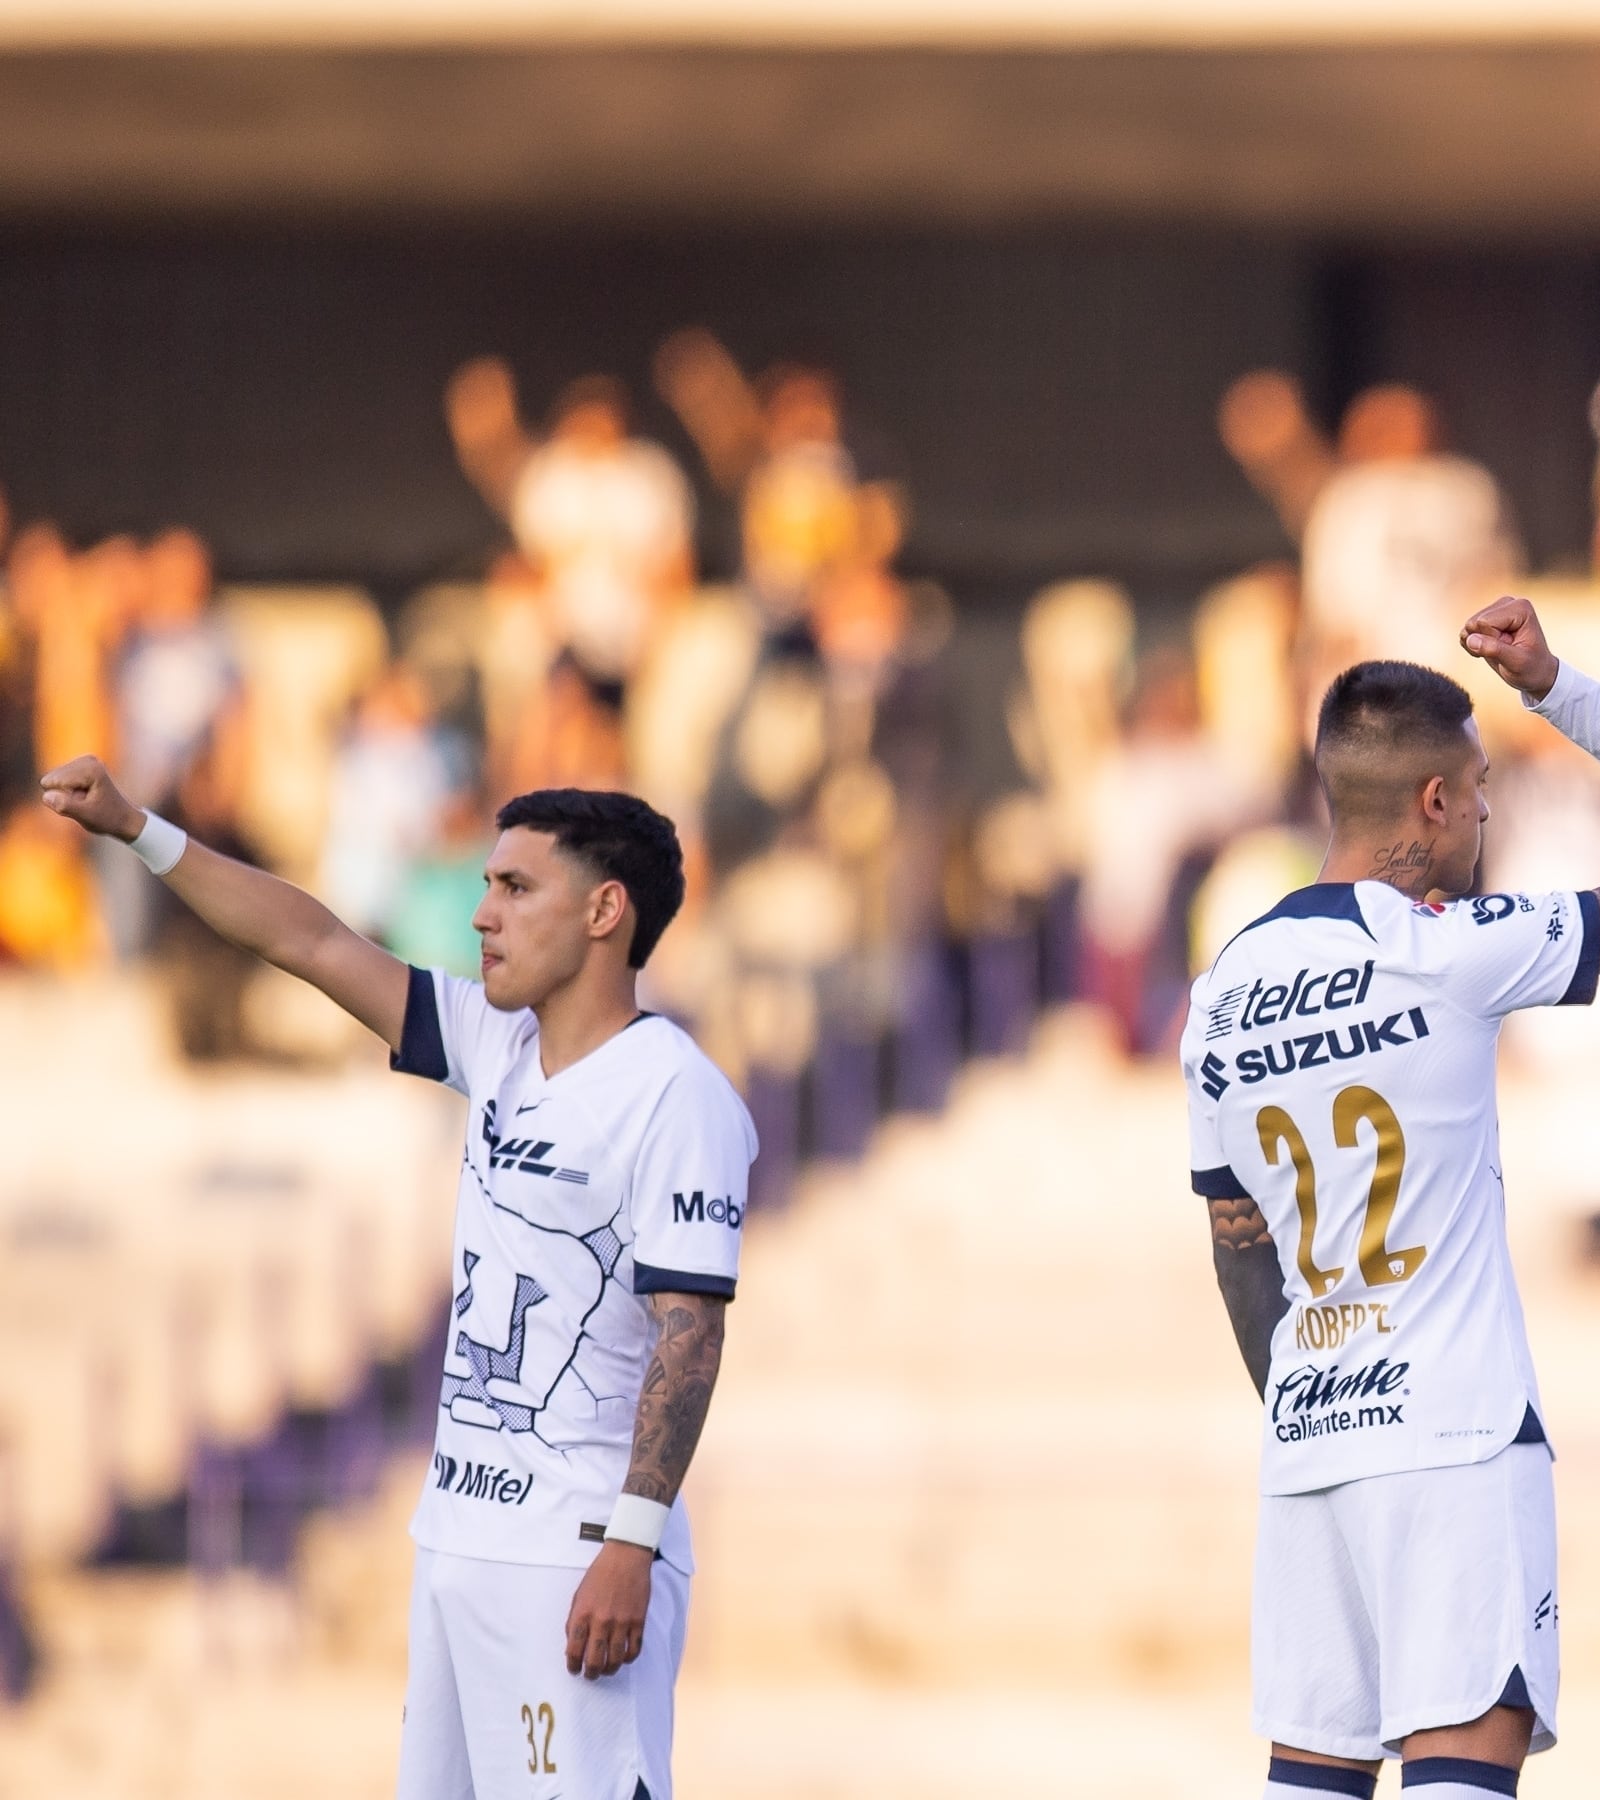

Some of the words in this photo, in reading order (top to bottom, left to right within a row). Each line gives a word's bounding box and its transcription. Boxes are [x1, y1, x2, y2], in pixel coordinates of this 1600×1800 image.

[1240, 959, 1376, 1031] telcel
[1235, 1006, 1430, 1084] SUZUKI
[1256, 1085, 1428, 1299] 22
[1276, 1404, 1404, 1443] caliente.mx
[455, 1461, 534, 1506] Mifel
[521, 1702, 557, 1775] 32
